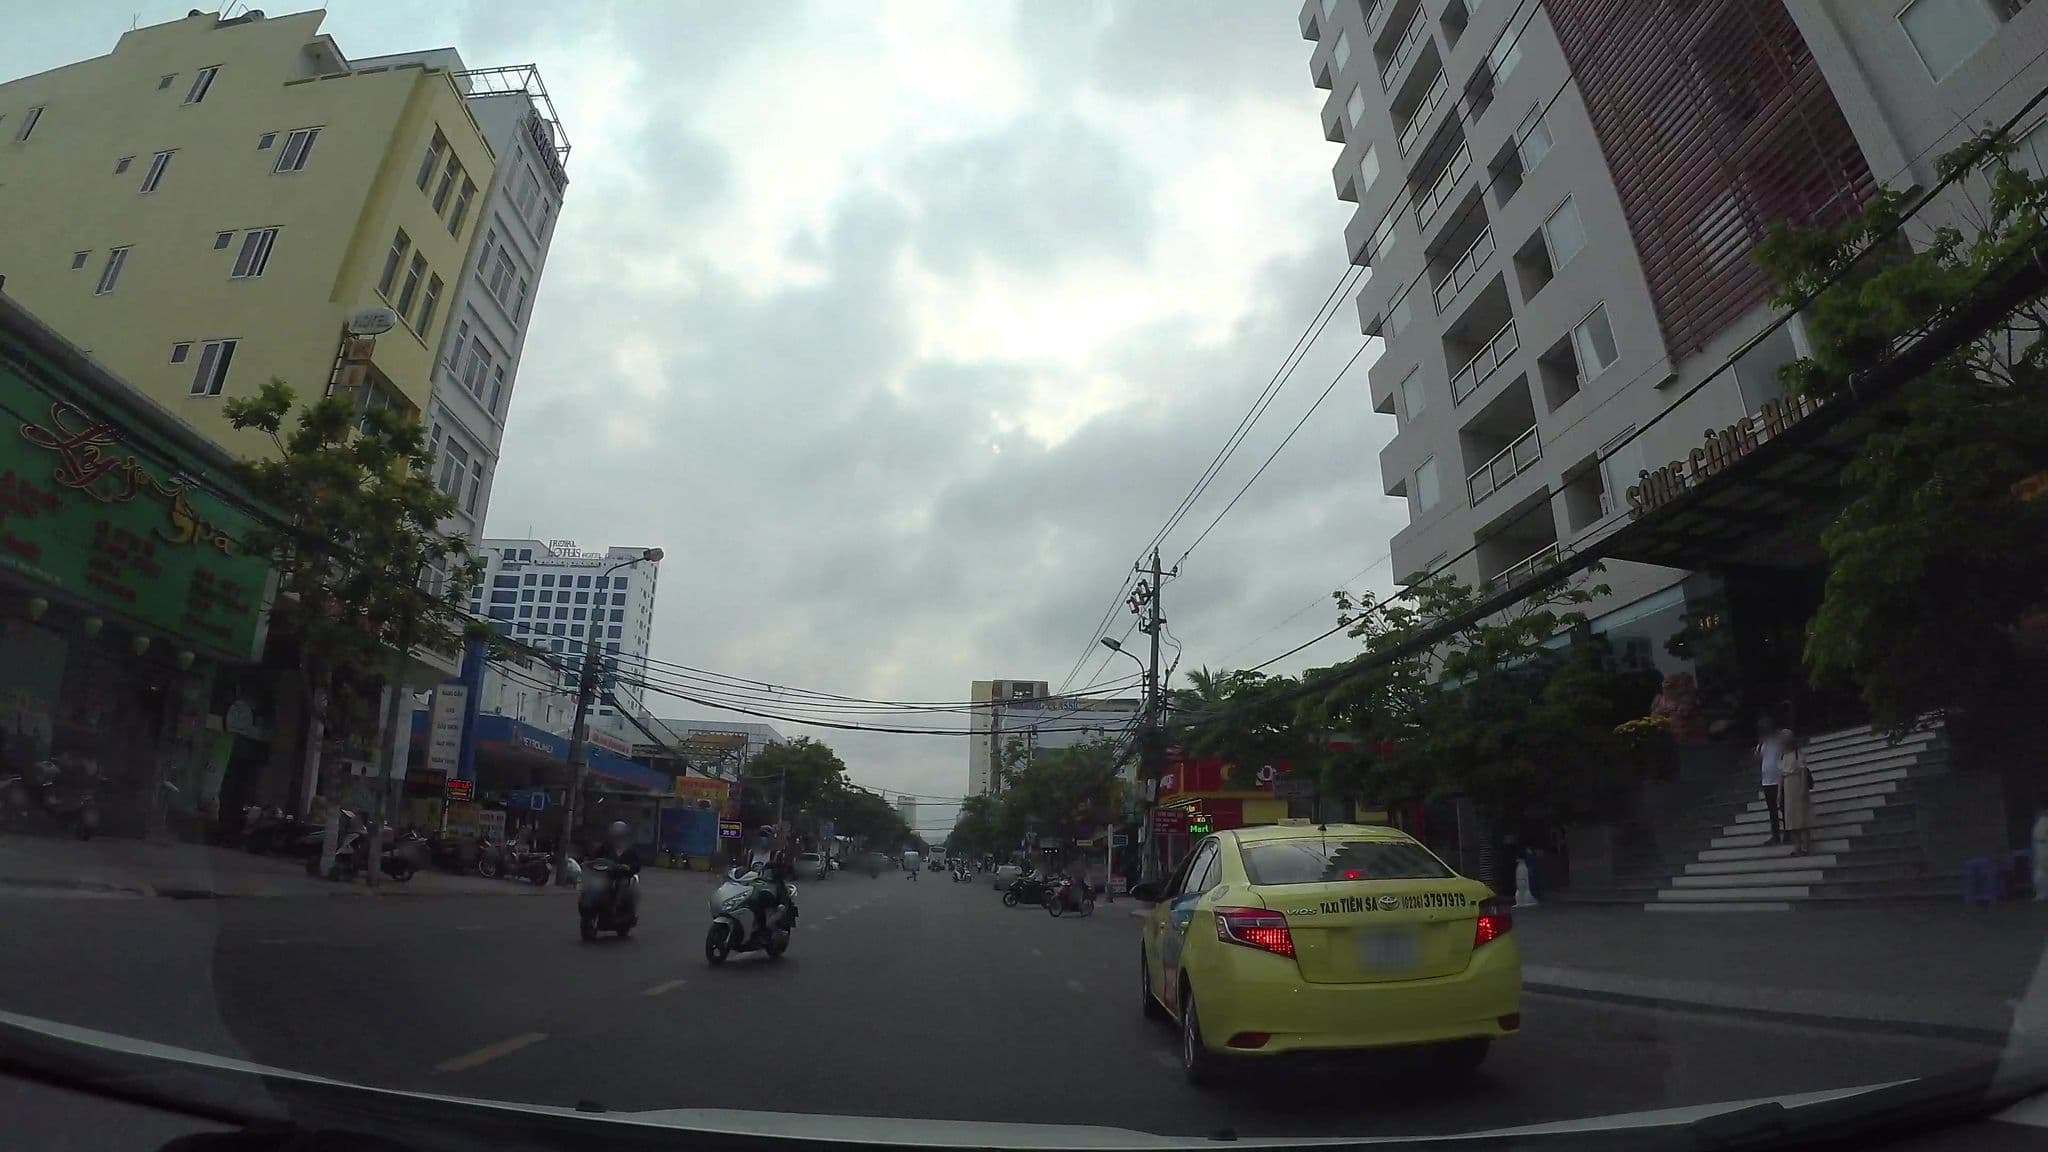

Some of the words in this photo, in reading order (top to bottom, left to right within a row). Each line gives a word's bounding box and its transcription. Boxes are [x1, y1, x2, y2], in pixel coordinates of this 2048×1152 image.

[1626, 461, 1687, 521] SÔNG
[1688, 417, 1758, 487] CÔNG
[548, 540, 581, 558] LOTUS
[1320, 902, 1339, 914] TAXI
[1365, 897, 1378, 912] SA
[1423, 892, 1466, 908] 3797979
